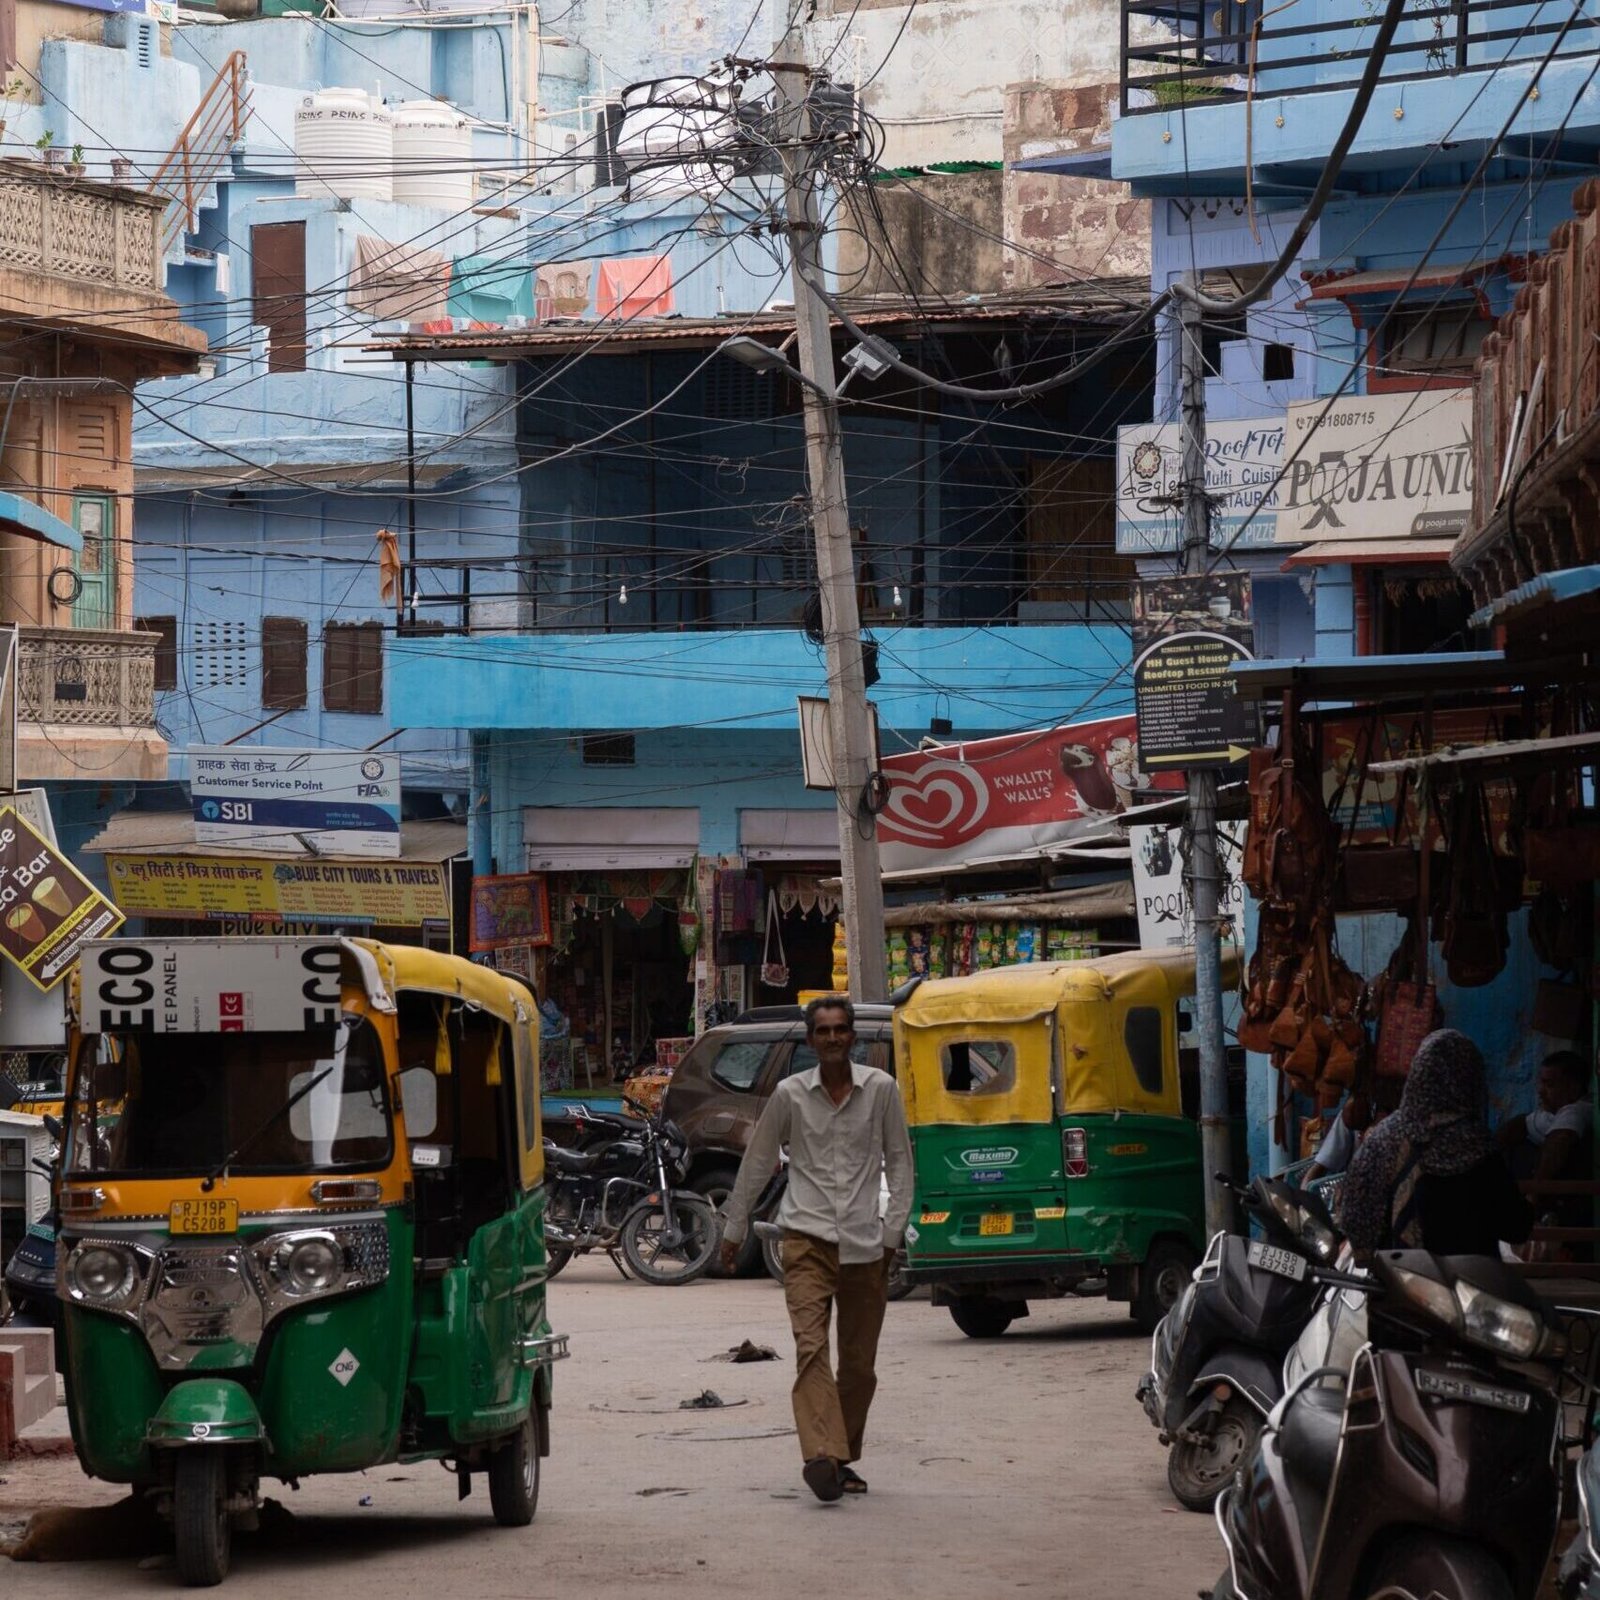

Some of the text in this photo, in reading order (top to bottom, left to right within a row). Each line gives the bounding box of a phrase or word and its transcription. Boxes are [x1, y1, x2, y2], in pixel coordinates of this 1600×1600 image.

[1285, 452, 1397, 507] POOJA
[1245, 523, 1275, 543] PIZZE
[1146, 659, 1162, 668] MH
[1166, 657, 1194, 667] Guest
[1198, 654, 1229, 664] House
[1143, 666, 1229, 680] Rooftop Restaur
[1138, 683, 1184, 694] UNLIMITED
[1185, 681, 1210, 691] FOOD
[1211, 680, 1221, 688] IN
[196, 758, 277, 772] ग्राहक सेवा केन्द्र
[197, 776, 324, 791] Customer Service Point
[993, 768, 1052, 789] KWALITY
[1003, 786, 1052, 804] WALL'S
[221, 801, 253, 821] SBI
[13, 849, 52, 888] Bar
[149, 860, 175, 878] सिटी
[187, 861, 210, 879] मित्र
[211, 863, 235, 879] सेवा
[236, 864, 264, 881] केन्द्र
[294, 865, 440, 886] BLUE CITY TOURS & TRAVELS
[1143, 892, 1185, 916] POOJ
[48, 936, 70, 957] Minute
[67, 929, 78, 940] By
[74, 915, 92, 932] Walk
[98, 946, 154, 1032] ECO
[163, 952, 177, 1008] PANEL
[301, 945, 342, 1032] ECO
[183, 1201, 226, 1217] RJ19P
[922, 1212, 947, 1223] STOP
[183, 1217, 226, 1232] C5208
[335, 1360, 354, 1373] CNG
